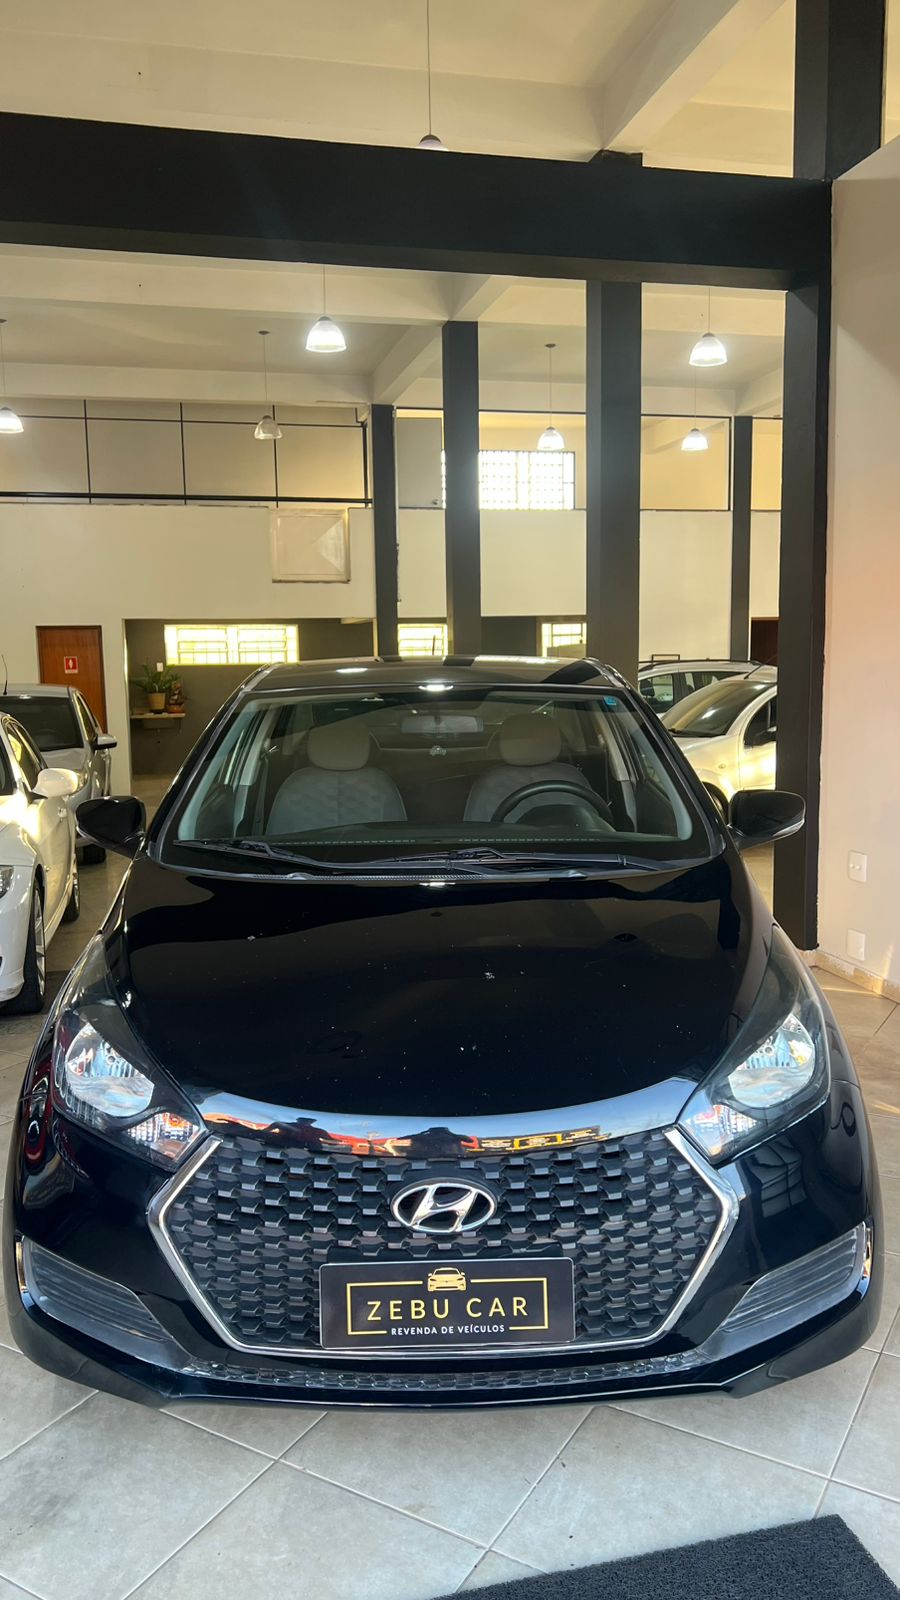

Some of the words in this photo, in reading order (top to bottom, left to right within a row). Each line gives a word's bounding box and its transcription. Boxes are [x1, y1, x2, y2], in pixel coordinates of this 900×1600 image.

[367, 1299, 449, 1321] ZEBU
[466, 1296, 528, 1318] CAR
[391, 1326, 438, 1336] REVENDA
[441, 1326, 455, 1335] DE
[457, 1324, 505, 1334] VEÍCULOS
